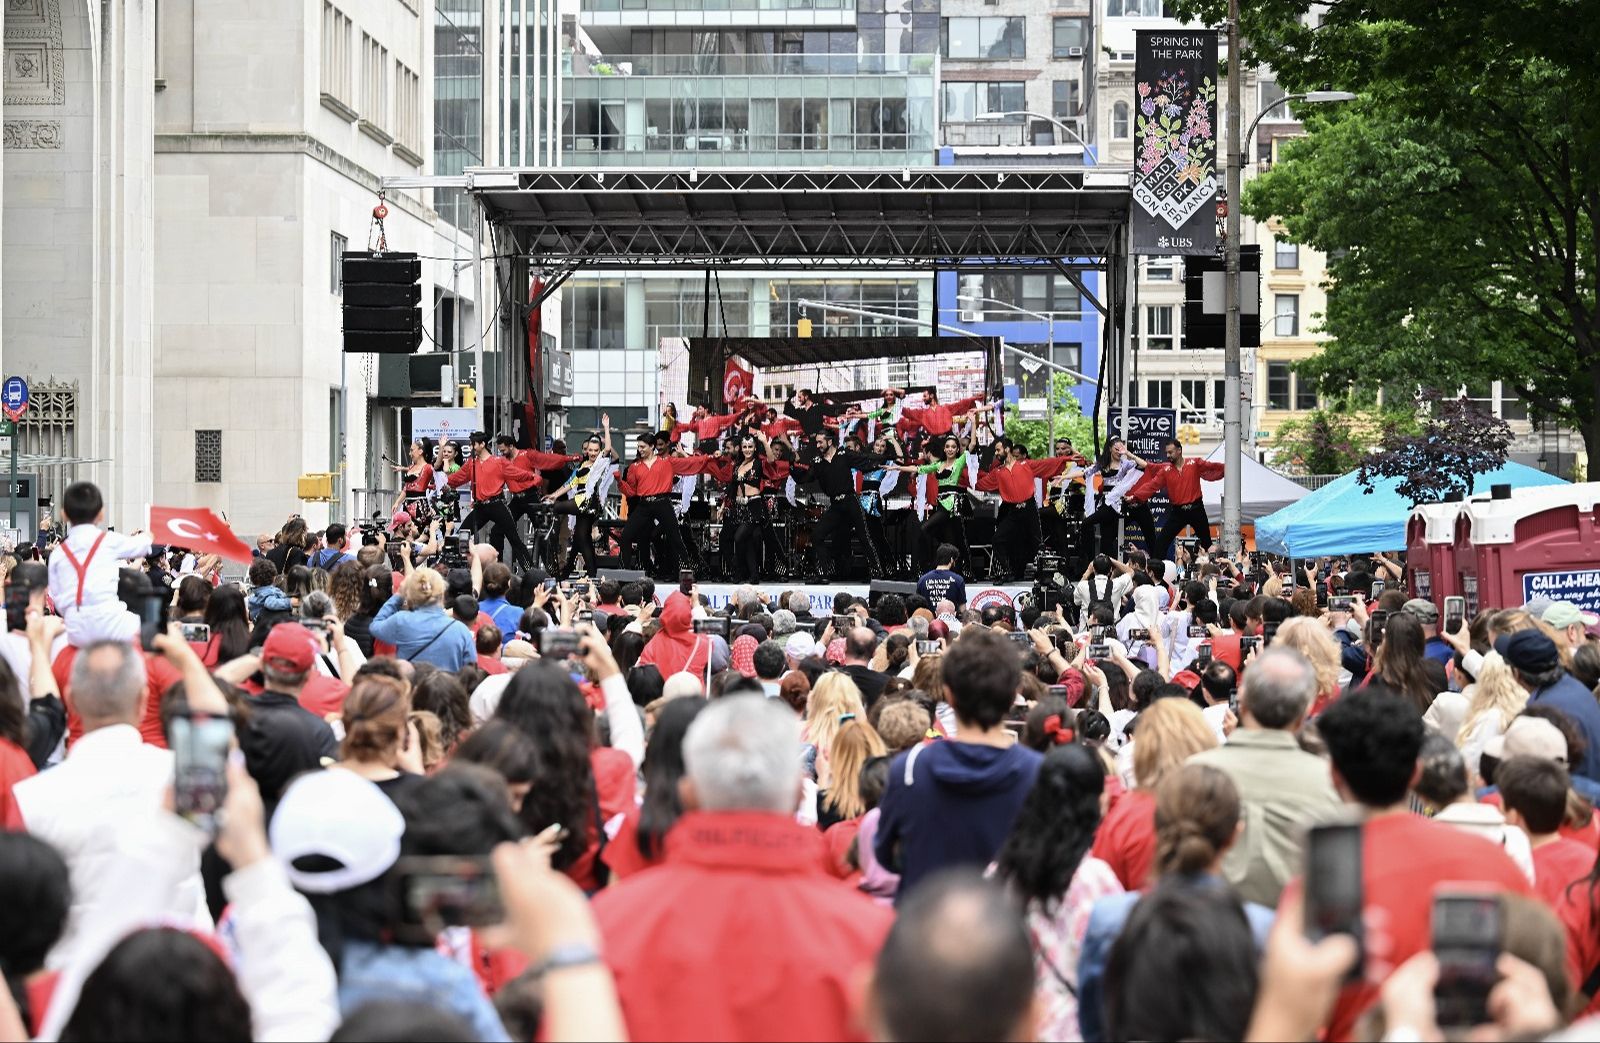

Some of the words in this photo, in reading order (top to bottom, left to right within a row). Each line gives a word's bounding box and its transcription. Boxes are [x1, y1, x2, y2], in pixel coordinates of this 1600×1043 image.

[1150, 36, 1189, 47] SPRING
[1192, 37, 1204, 47] IN
[1152, 49, 1172, 59] THE
[1175, 49, 1203, 59] PARK
[1145, 163, 1173, 188] MAD.
[1156, 182, 1177, 198] SQ.
[1174, 183, 1194, 201] PK.
[1171, 237, 1193, 248] UBS
[1564, 592, 1586, 601] way
